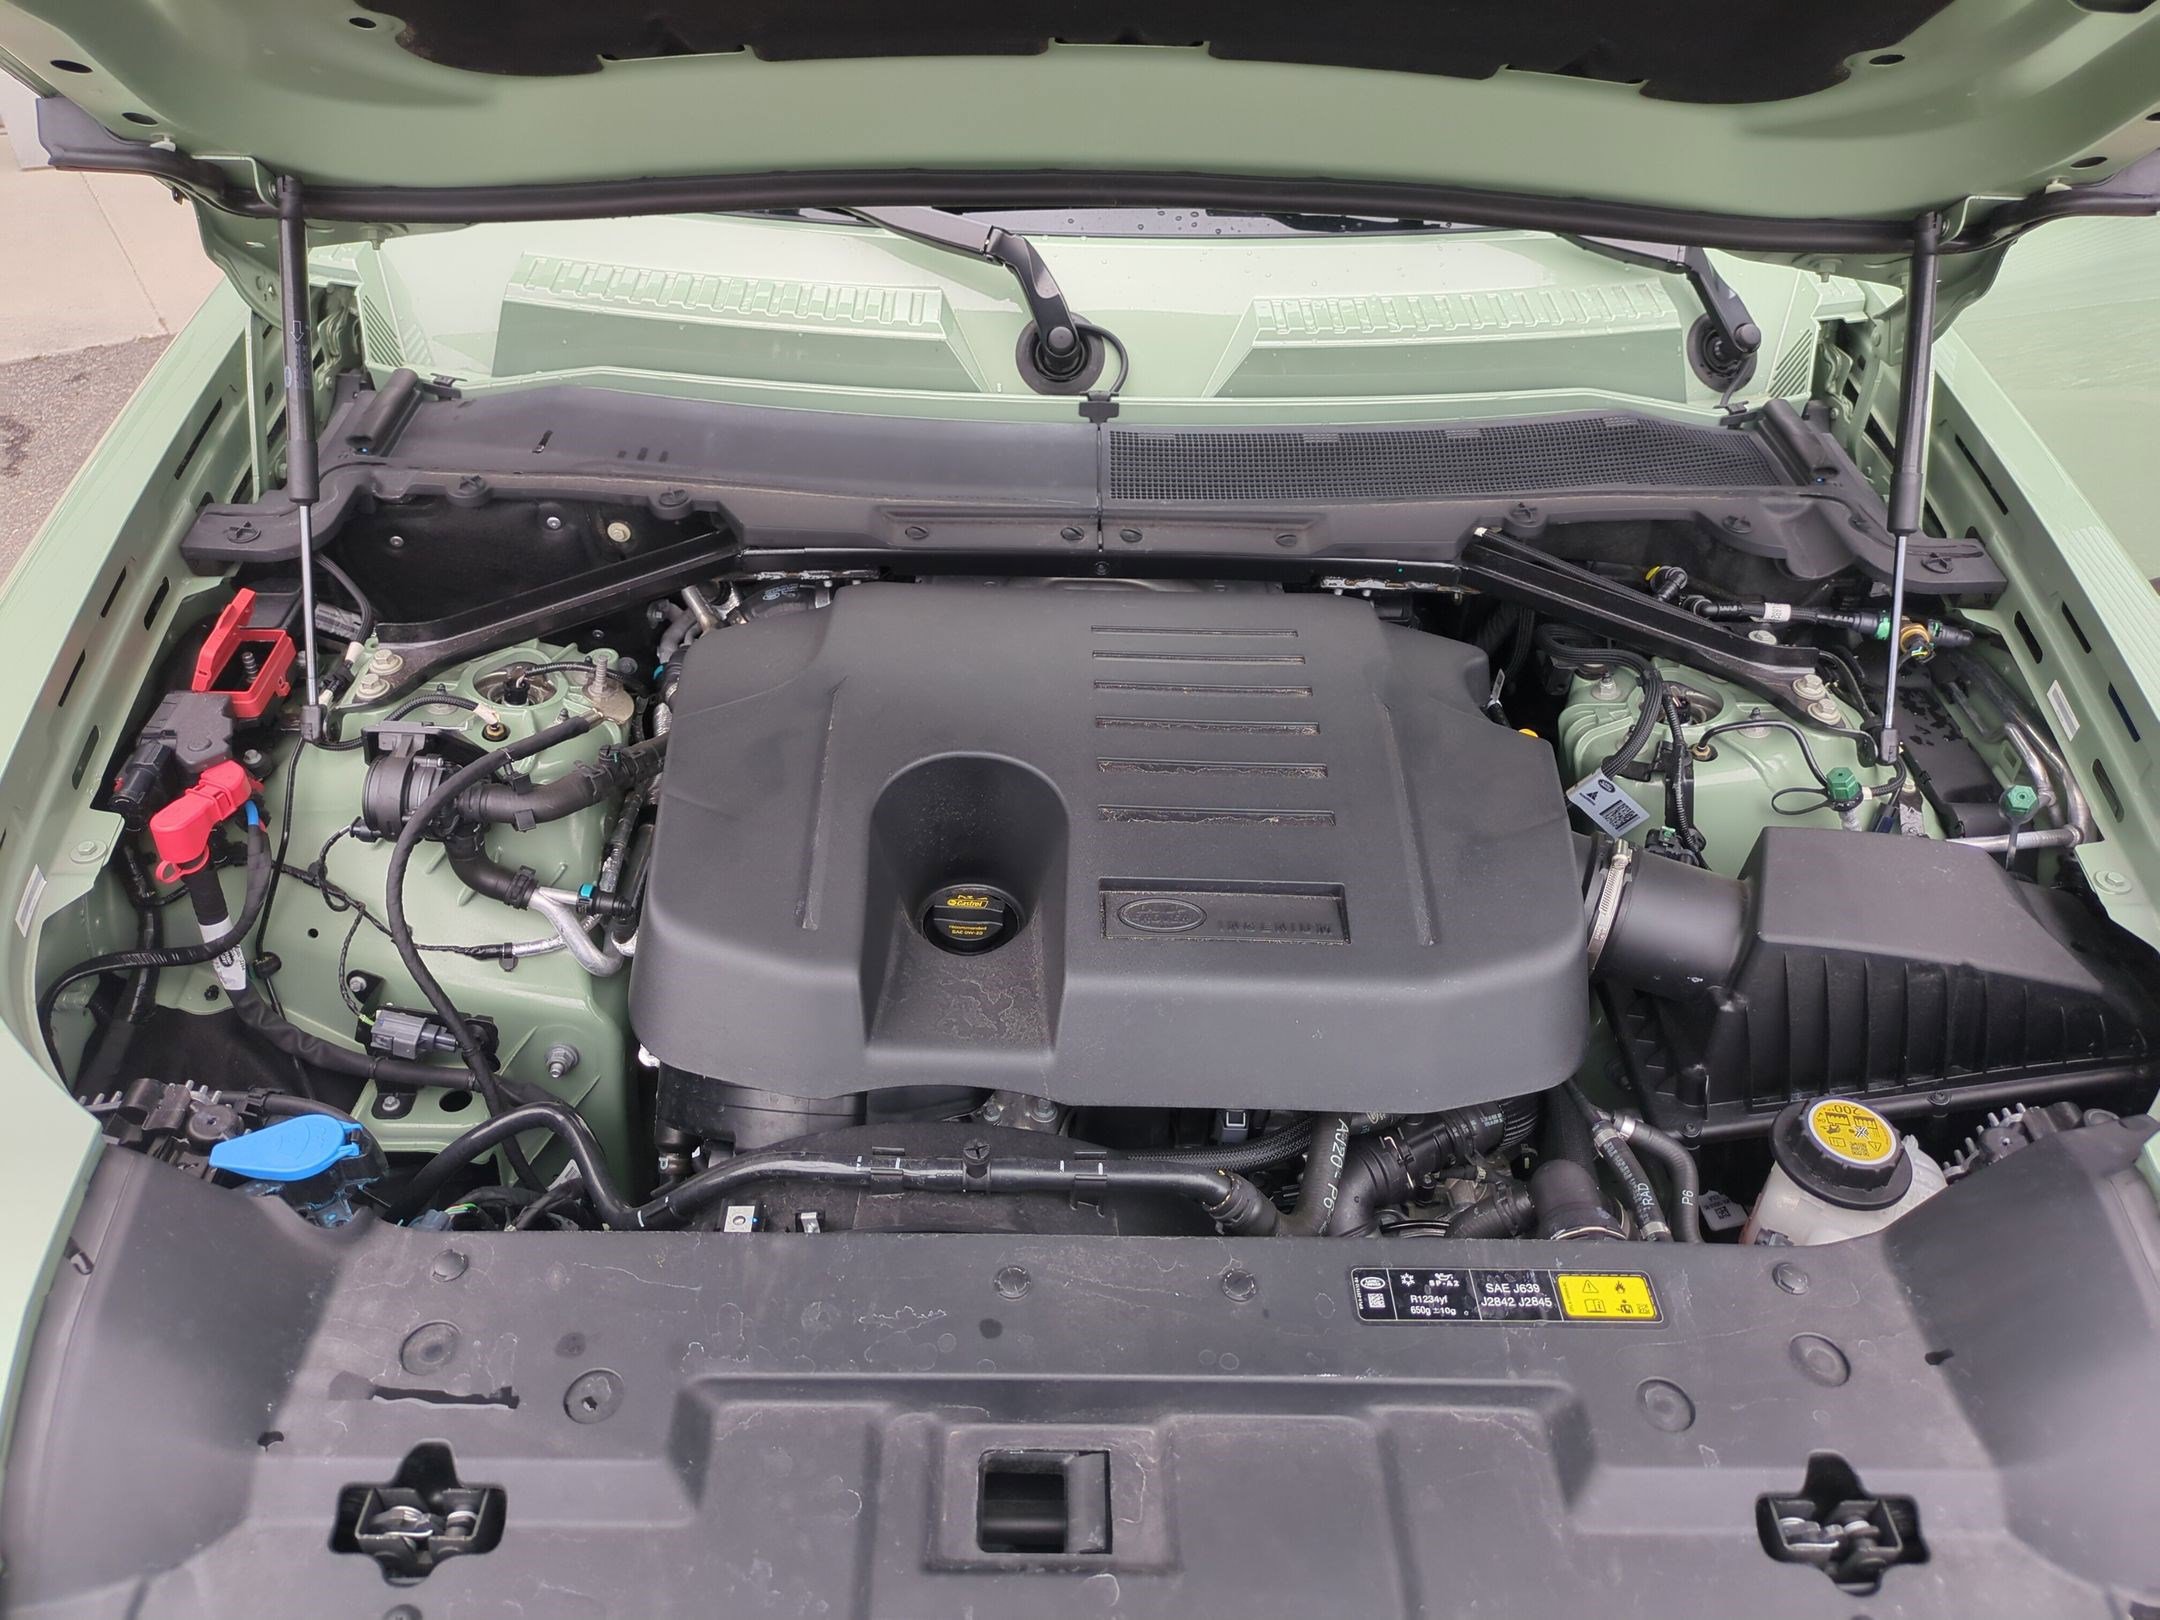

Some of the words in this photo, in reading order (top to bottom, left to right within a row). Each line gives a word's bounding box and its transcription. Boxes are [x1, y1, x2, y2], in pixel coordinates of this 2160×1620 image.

[1637, 1183, 1654, 1206] RAD
[1681, 1189, 1694, 1206] P6
[1485, 1283, 1511, 1293] SAE
[1513, 1283, 1540, 1293] J639
[1410, 1294, 1448, 1305] R1234yf
[1481, 1297, 1516, 1307] J2842
[1518, 1297, 1553, 1307] J2845
[1410, 1305, 1432, 1316] 650g
